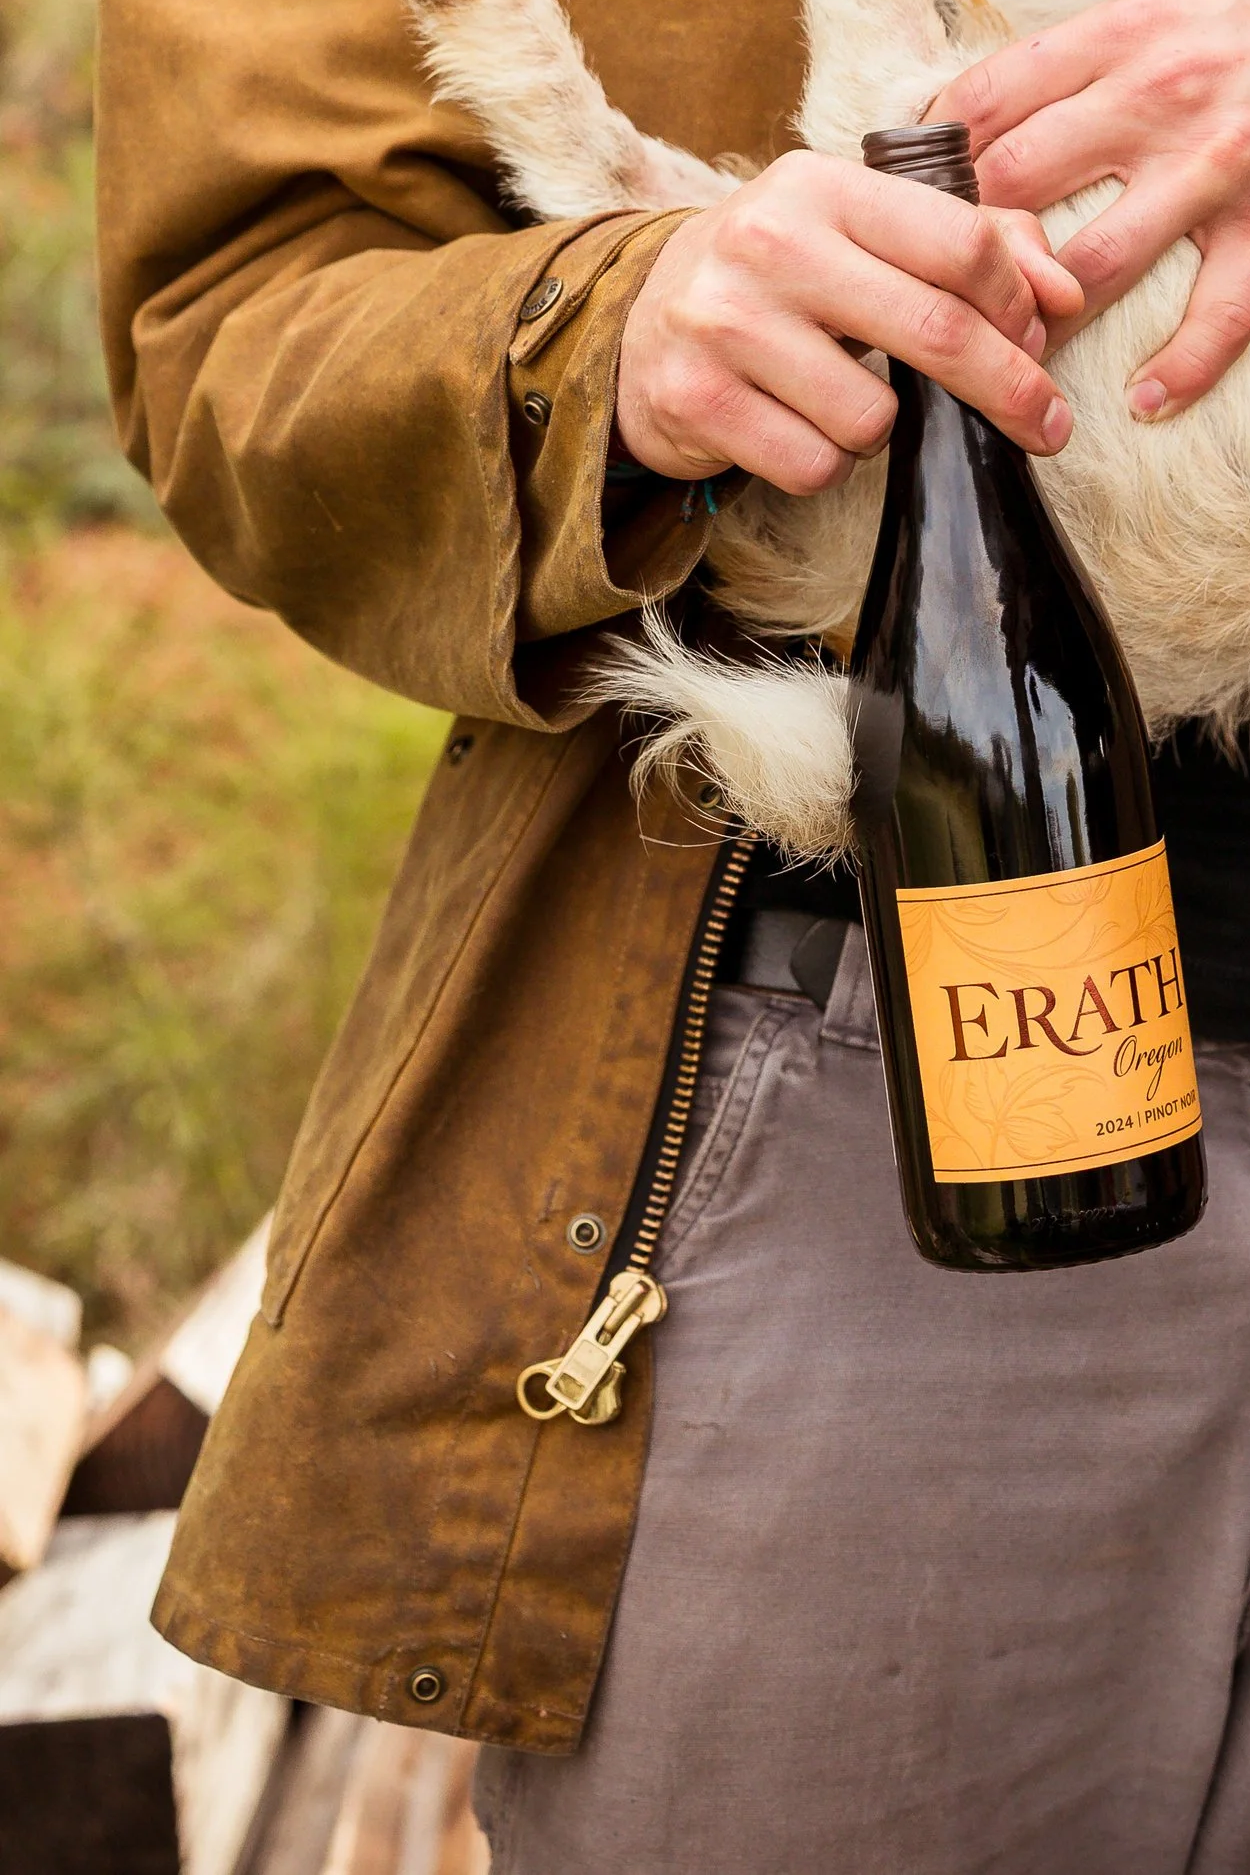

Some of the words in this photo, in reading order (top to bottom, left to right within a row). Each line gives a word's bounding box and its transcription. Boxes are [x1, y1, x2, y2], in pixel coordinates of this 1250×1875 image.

[939, 947, 1185, 1062] ERATH
[1113, 1034, 1183, 1102] Oregon
[1095, 1115, 1134, 1137] 2024
[1144, 1099, 1179, 1124] PINOT
